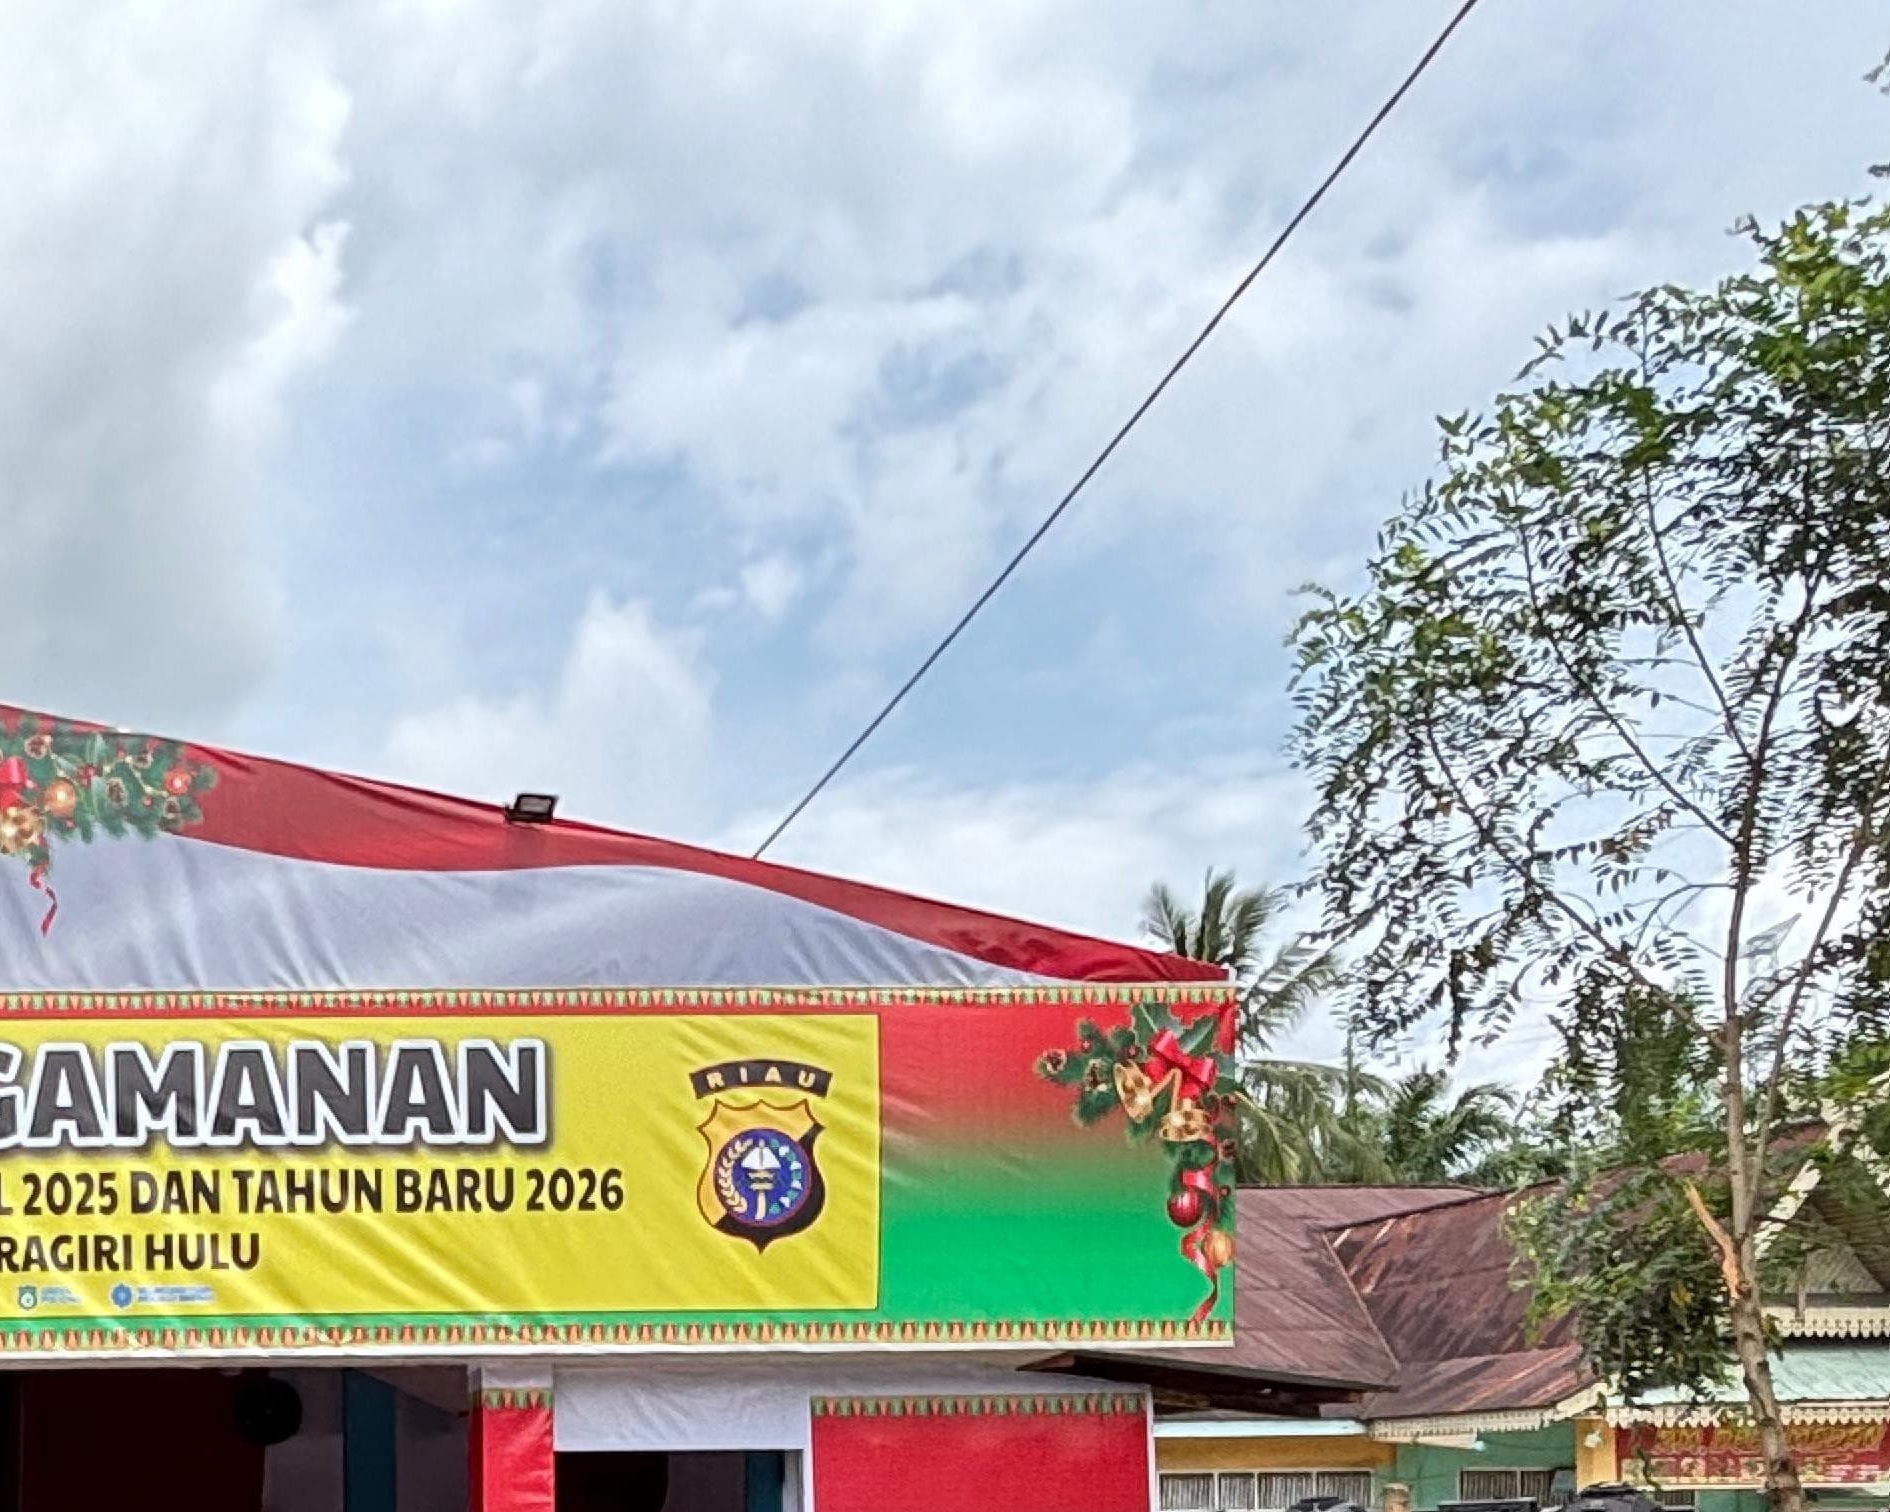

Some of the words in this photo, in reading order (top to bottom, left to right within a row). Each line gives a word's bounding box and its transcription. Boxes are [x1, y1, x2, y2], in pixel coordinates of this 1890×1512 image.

[706, 1066, 816, 1090] RIAU
[21, 1171, 119, 1217] 2025
[130, 1169, 221, 1215] DAN
[231, 1167, 383, 1214] TAHUN
[395, 1167, 515, 1213] BARU
[525, 1167, 625, 1212] 2026
[145, 1232, 260, 1271] HULU
